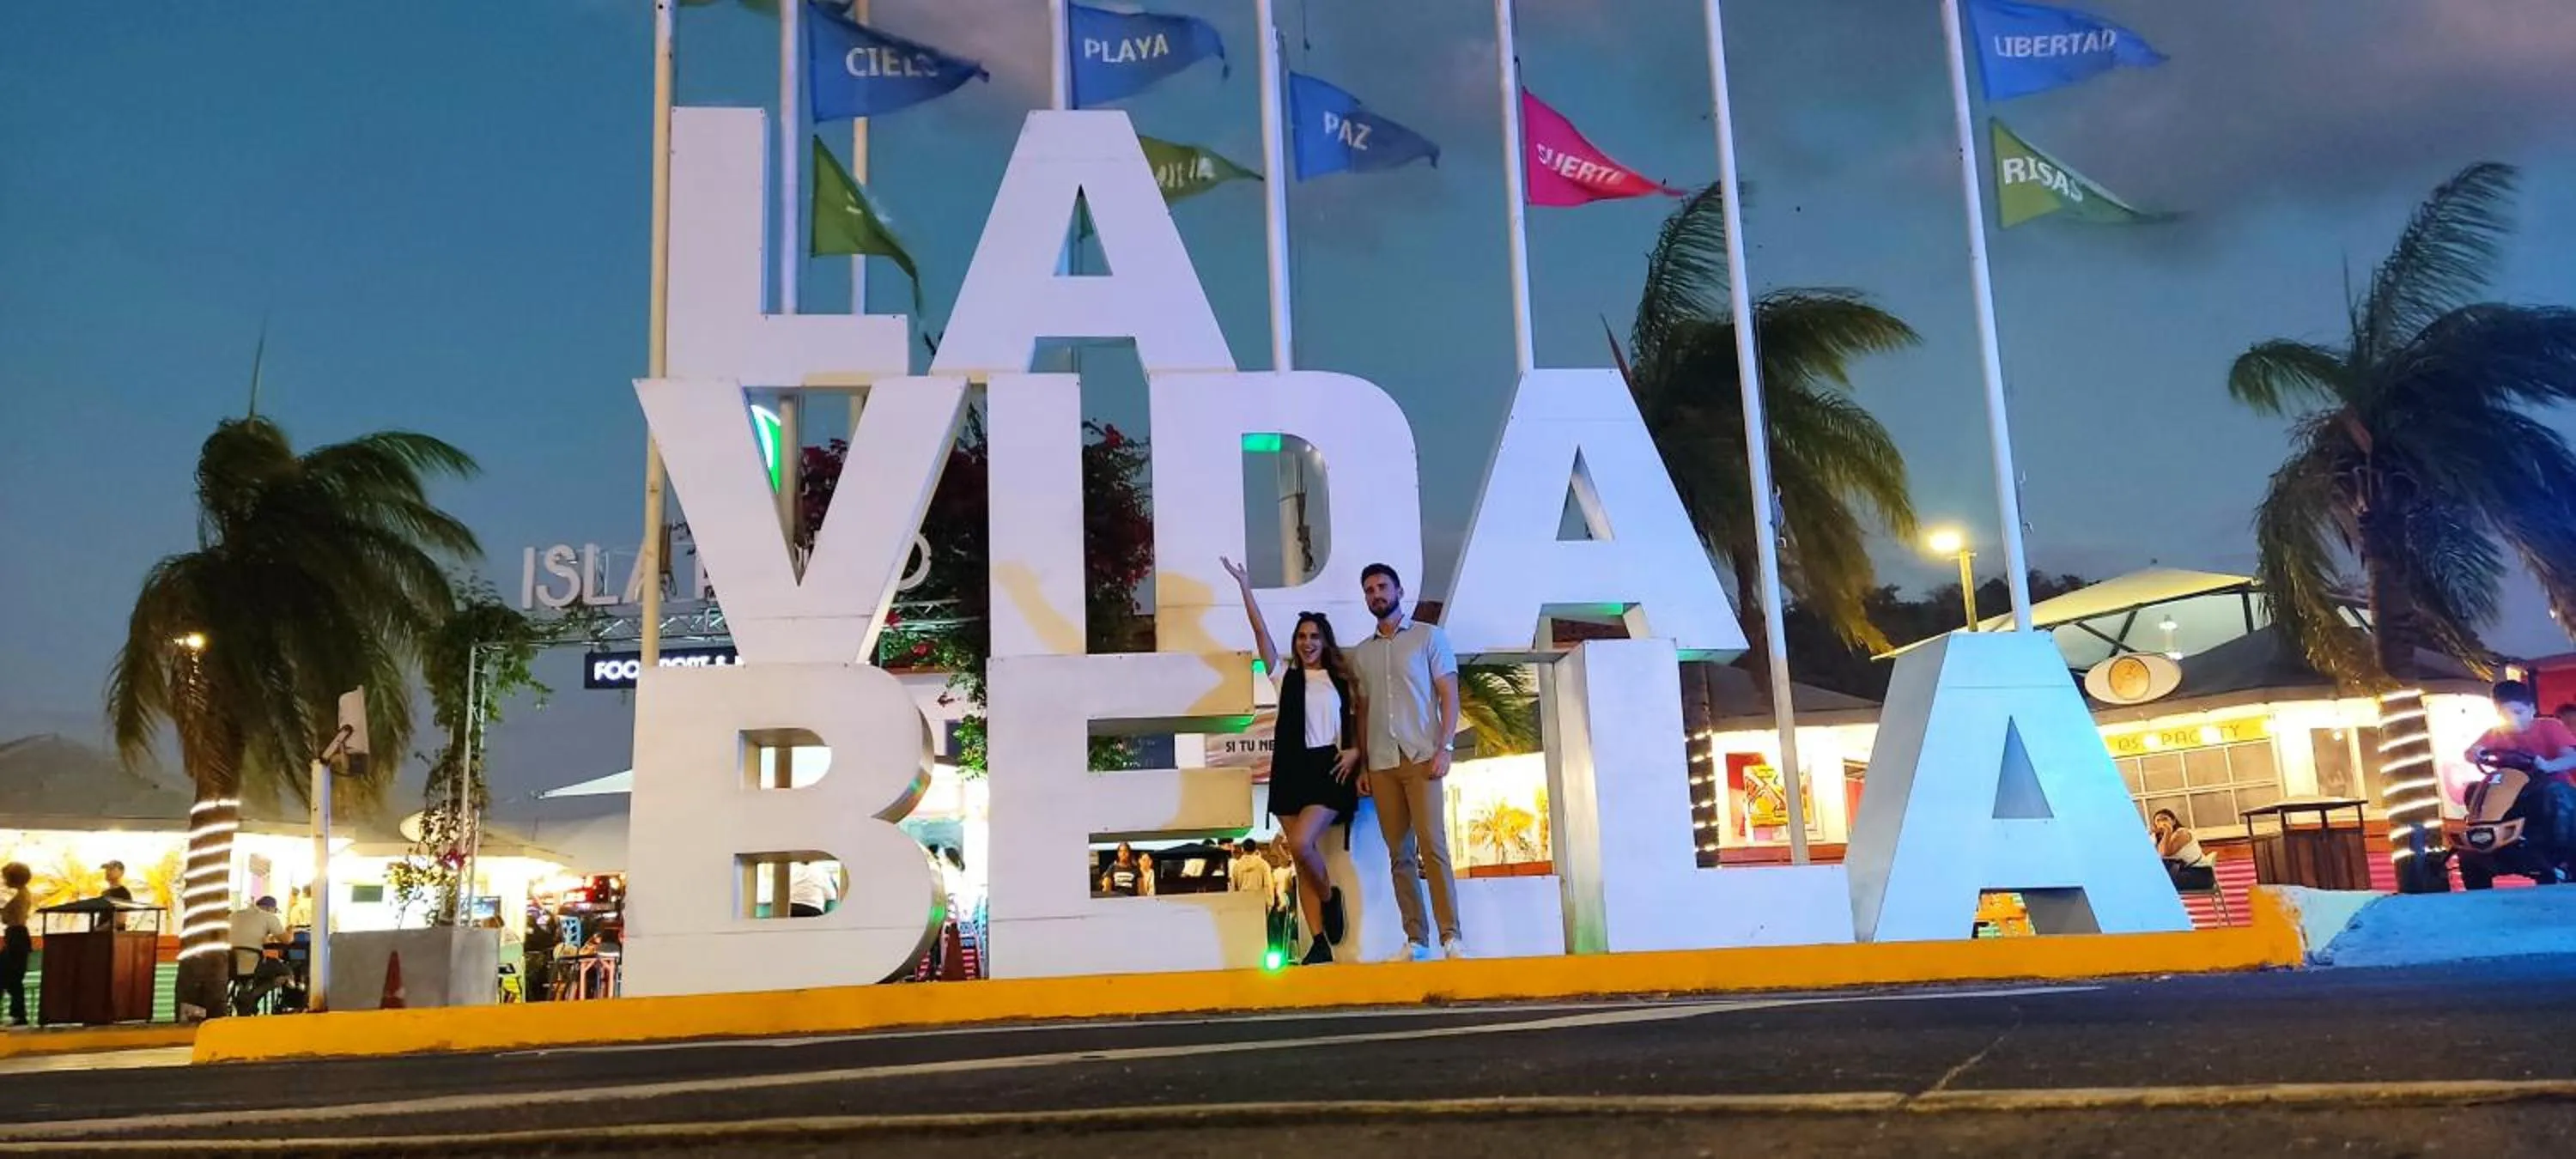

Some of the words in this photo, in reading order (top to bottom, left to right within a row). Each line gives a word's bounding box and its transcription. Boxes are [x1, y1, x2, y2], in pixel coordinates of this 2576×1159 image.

[1084, 33, 1170, 63] PLAYA
[1994, 28, 2117, 58] LIBERTAD
[1323, 110, 1374, 151] PAZ
[2002, 156, 2084, 202] RISAS
[665, 106, 1236, 377] LA
[634, 367, 1748, 668] VIDA
[592, 658, 640, 681] FOO
[1225, 741, 1236, 752] SI
[1239, 740, 1255, 751] TU
